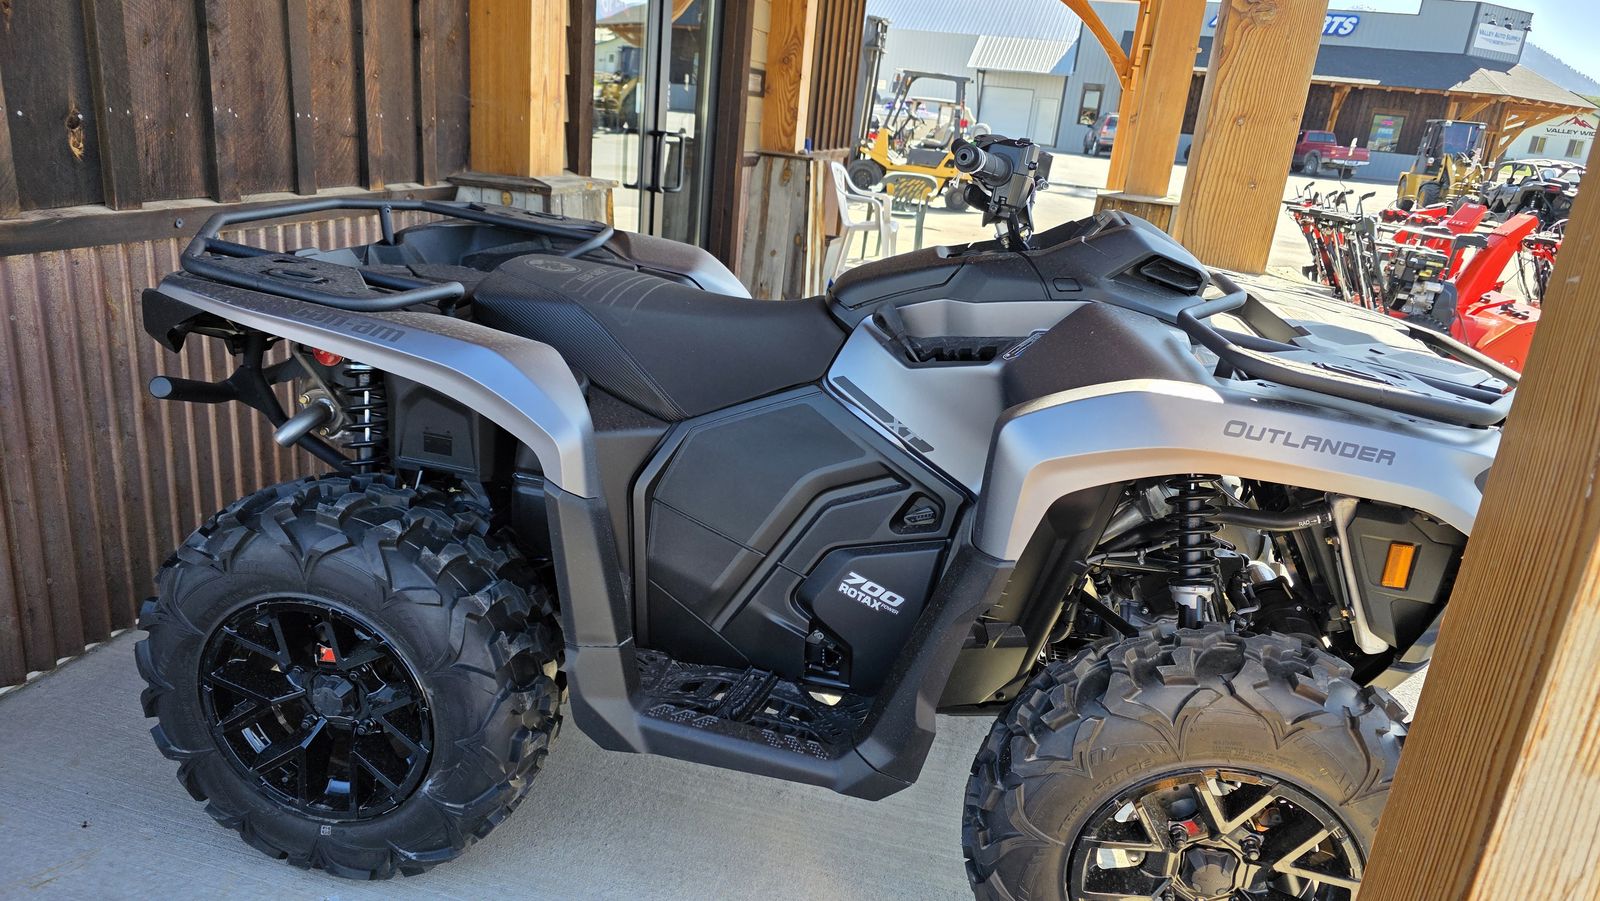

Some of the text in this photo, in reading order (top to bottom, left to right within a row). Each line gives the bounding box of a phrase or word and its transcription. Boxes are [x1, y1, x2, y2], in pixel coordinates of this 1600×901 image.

[1546, 127, 1578, 135] VALLEY
[1223, 419, 1396, 466] OUTLANDER
[838, 582, 899, 615] ROTAX POWER
[843, 571, 905, 607] 700
